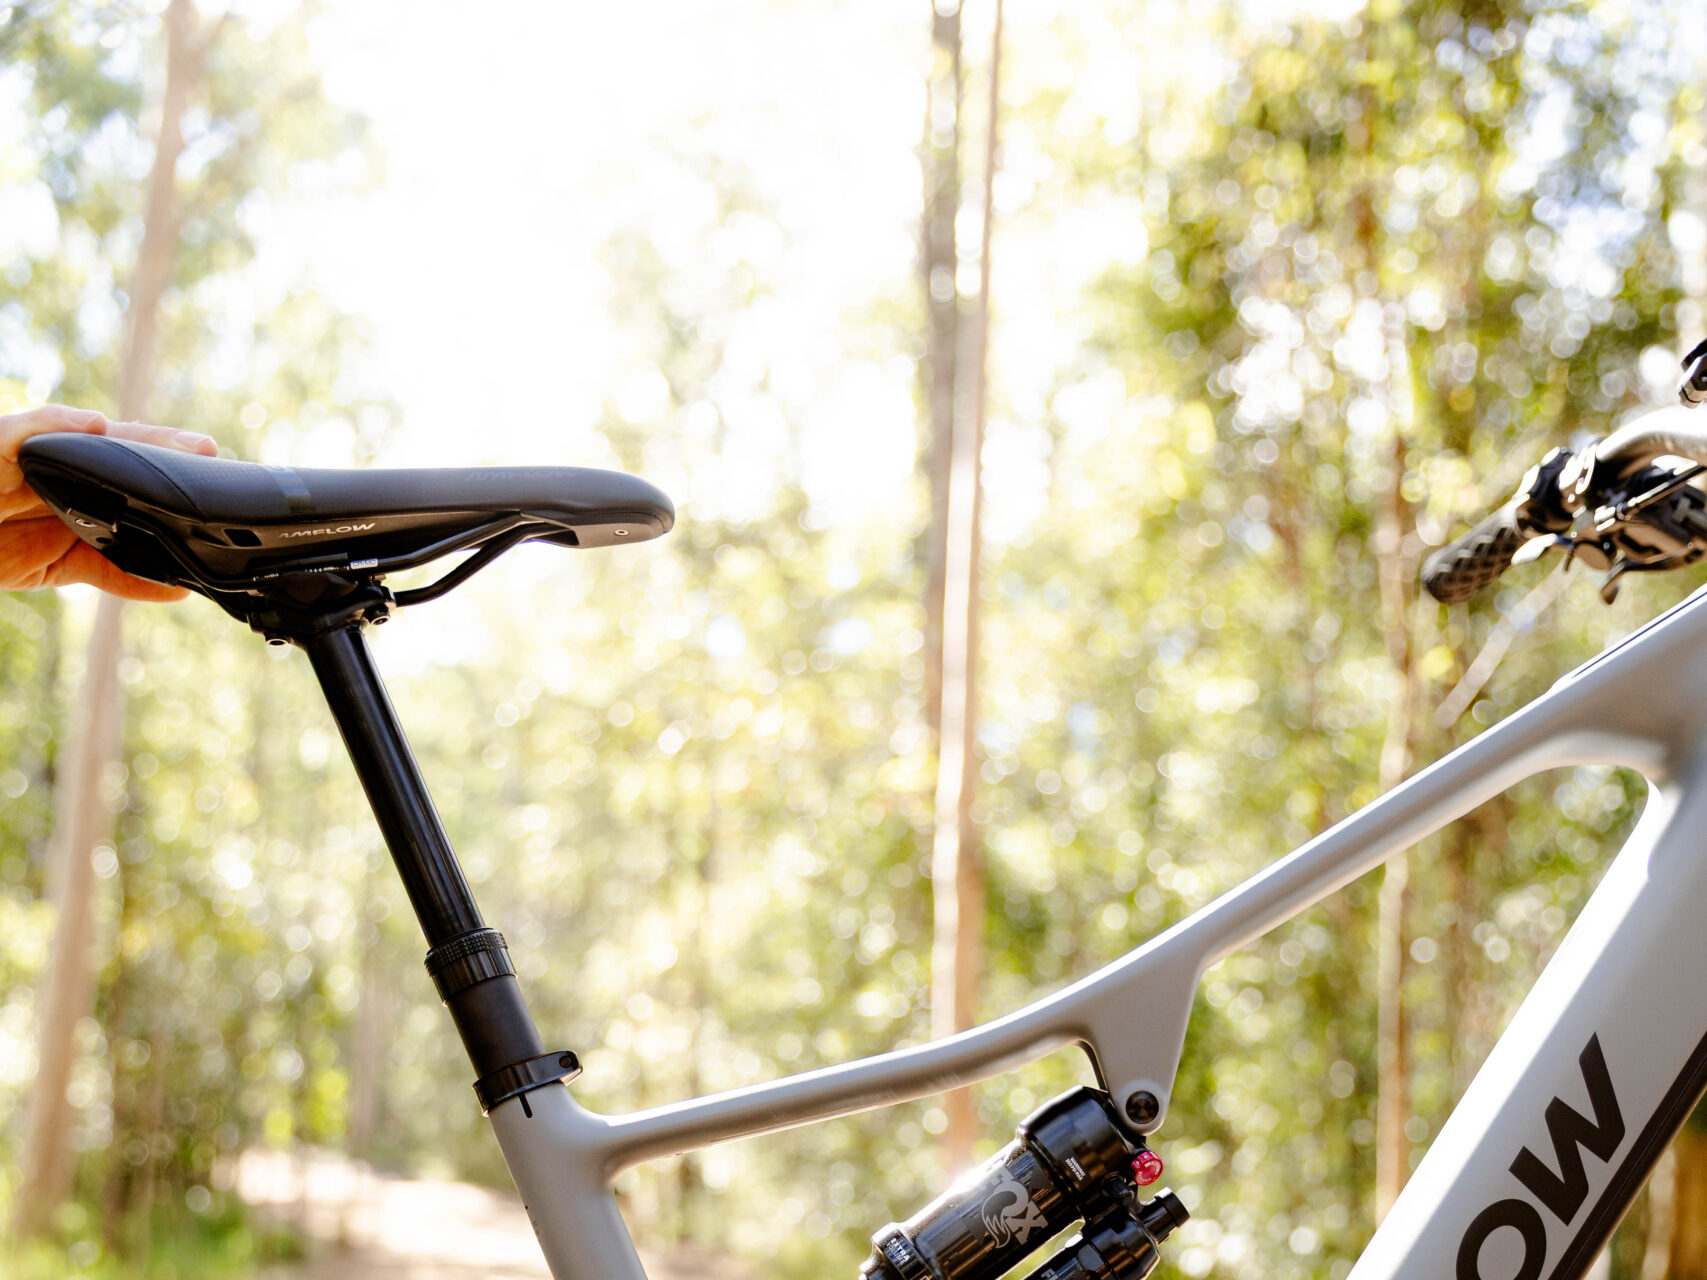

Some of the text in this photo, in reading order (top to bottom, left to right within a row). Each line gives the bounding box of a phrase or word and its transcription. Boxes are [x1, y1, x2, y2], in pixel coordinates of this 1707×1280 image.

[279, 522, 377, 539] AMFLOW
[982, 1154, 1049, 1249] FOX
[890, 1237, 911, 1261] EXTRA
